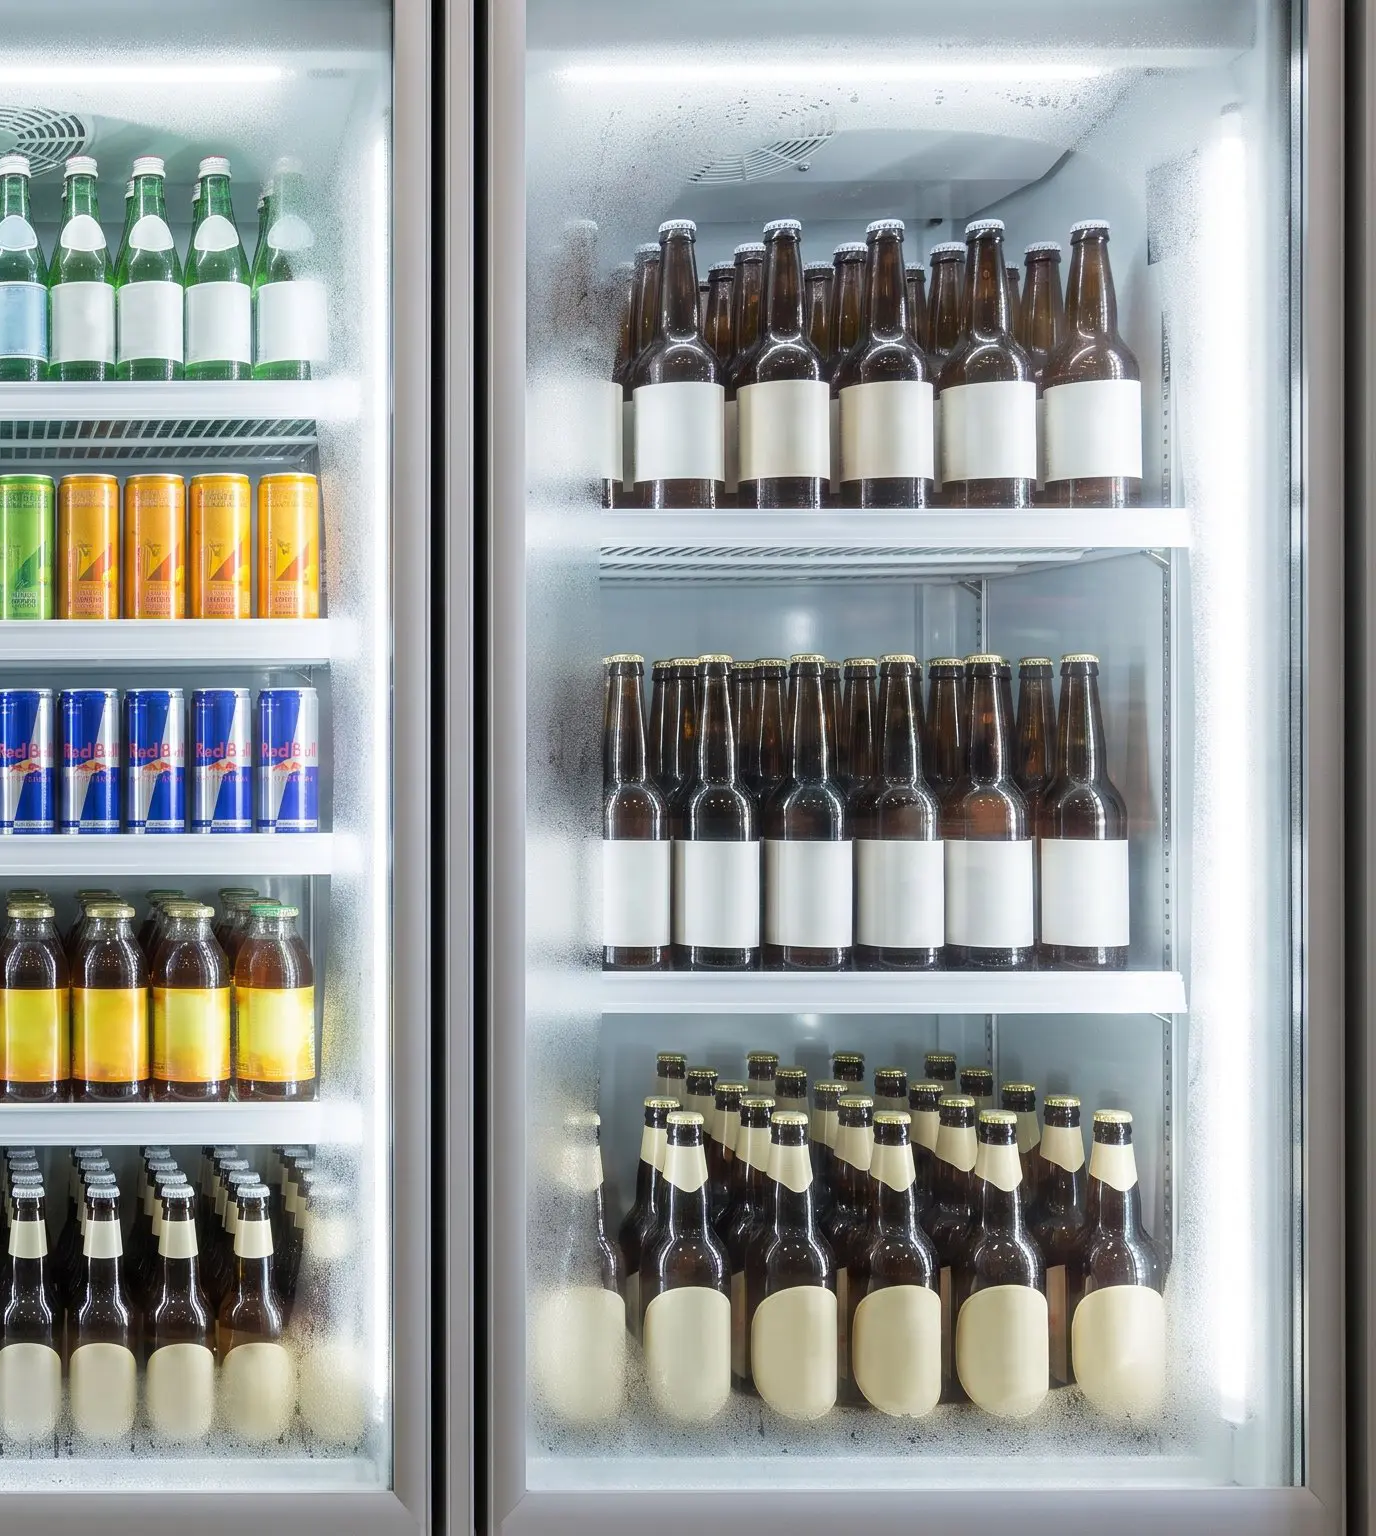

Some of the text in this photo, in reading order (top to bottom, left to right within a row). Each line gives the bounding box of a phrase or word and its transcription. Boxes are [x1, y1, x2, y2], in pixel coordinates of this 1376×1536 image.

[64, 742, 92, 758] Red
[129, 742, 157, 758] Red
[196, 742, 224, 758] Red
[261, 742, 289, 758] Red
